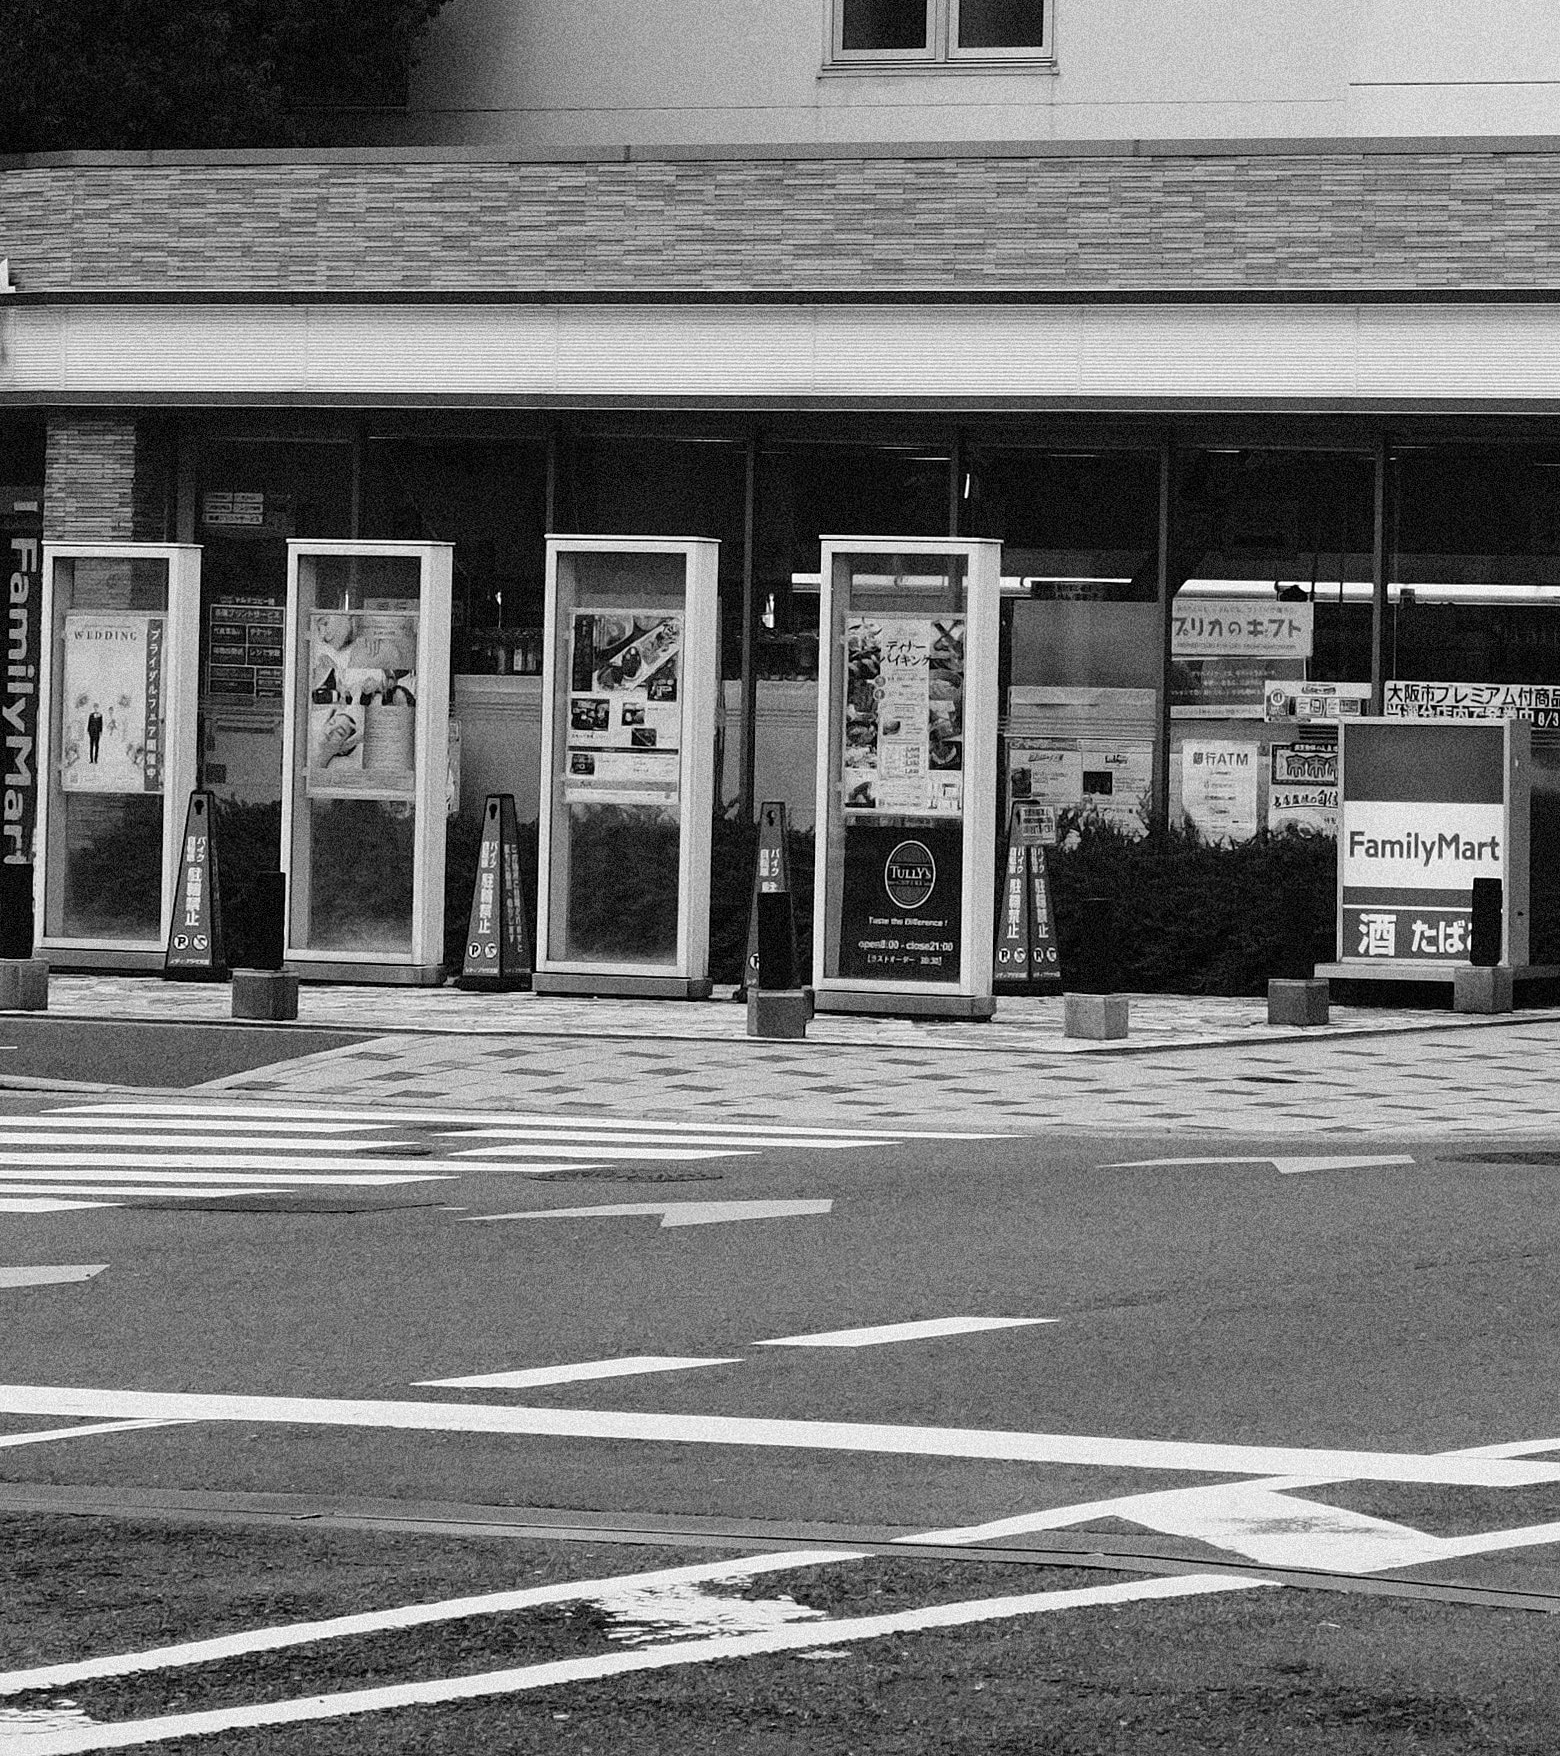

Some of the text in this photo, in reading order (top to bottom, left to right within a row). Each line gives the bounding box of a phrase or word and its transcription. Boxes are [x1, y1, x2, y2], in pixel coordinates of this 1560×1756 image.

[74, 630, 138, 641] WEDDING
[2, 538, 38, 865] FamilyMart
[1349, 831, 1500, 867] FamilyMart
[1358, 913, 1472, 956] 酒 たば
